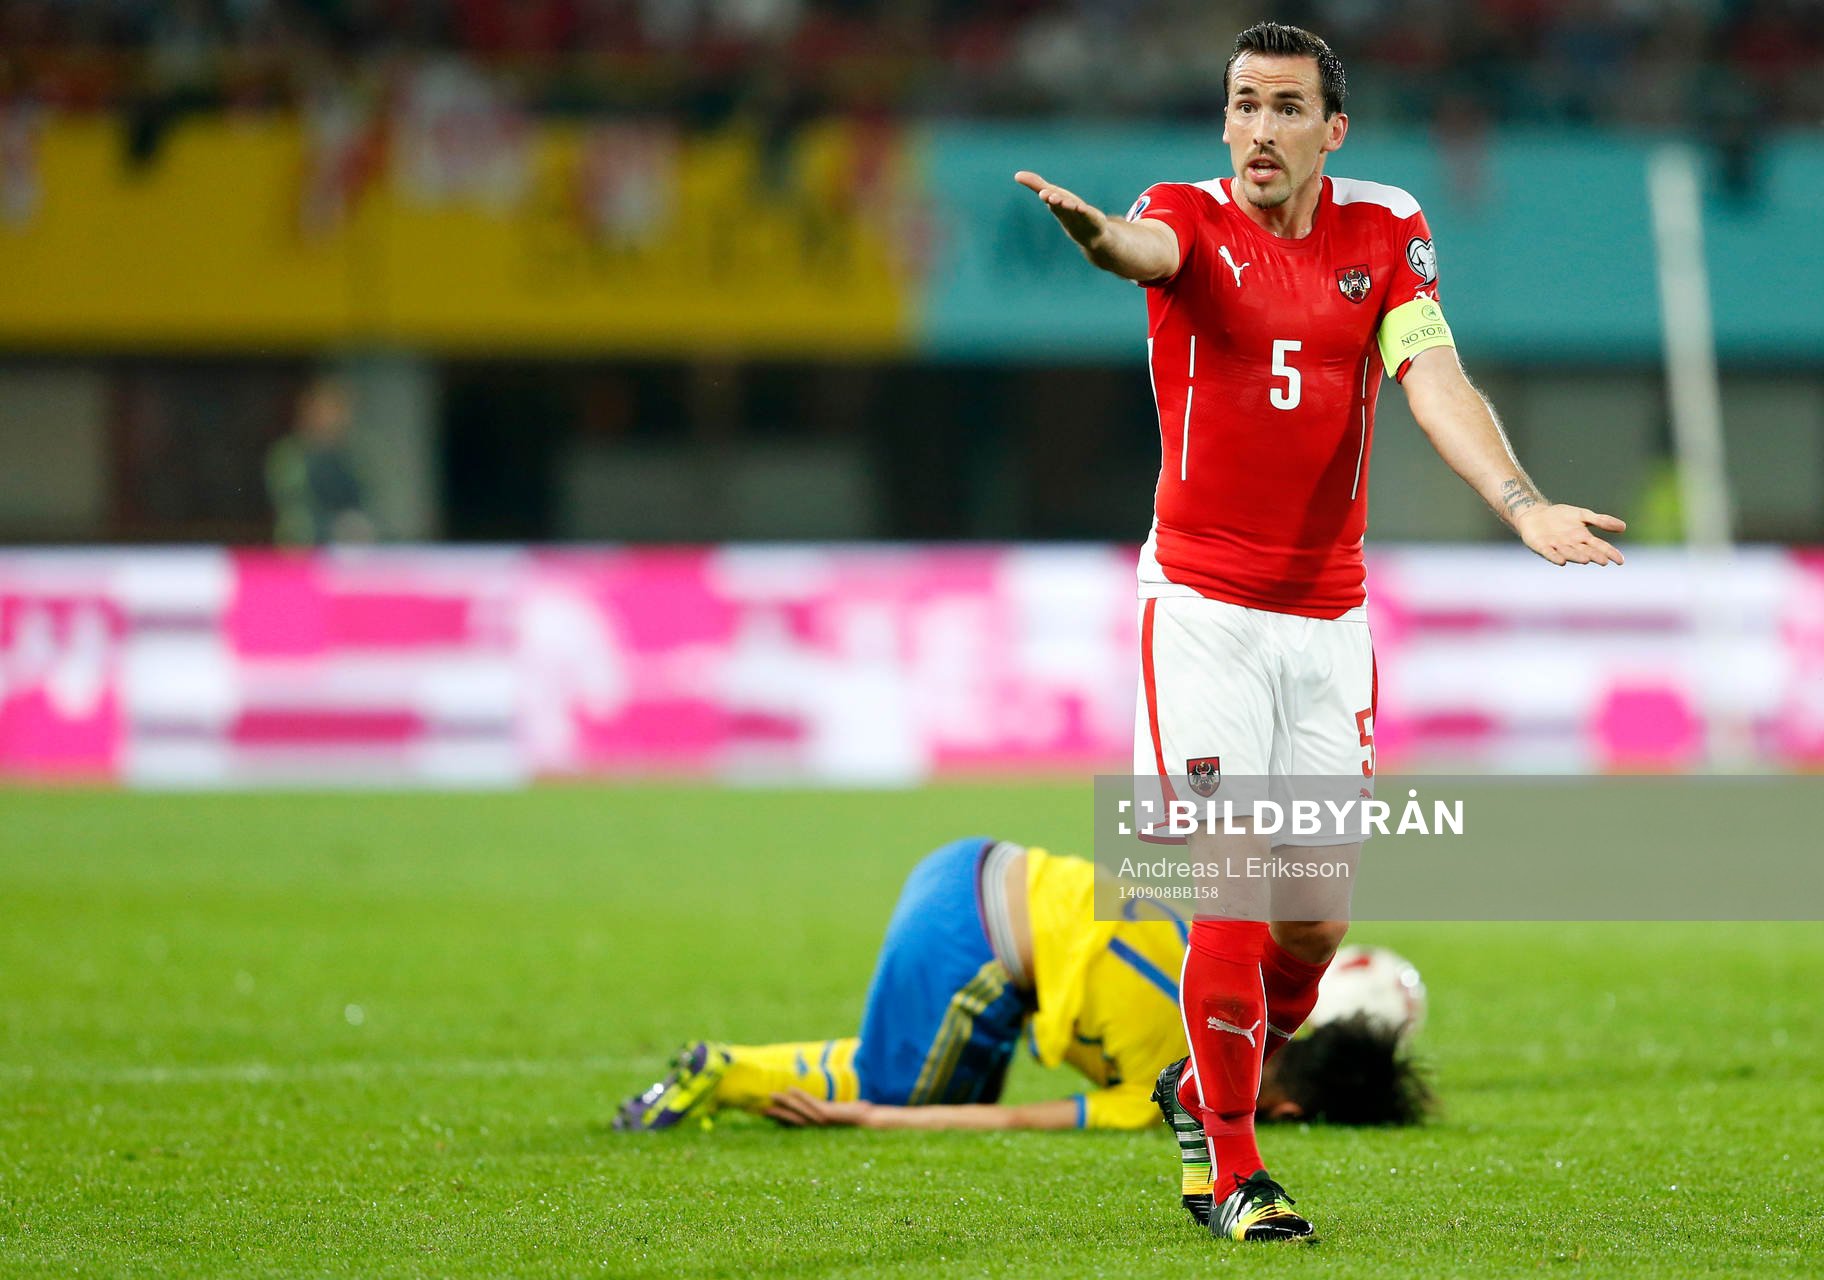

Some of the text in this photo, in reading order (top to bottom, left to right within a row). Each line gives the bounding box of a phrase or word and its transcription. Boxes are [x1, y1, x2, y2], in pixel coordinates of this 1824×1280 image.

[1401, 333, 1418, 346] NO
[1420, 327, 1435, 336] TO
[1270, 340, 1301, 410] 5
[1355, 708, 1375, 779] 5
